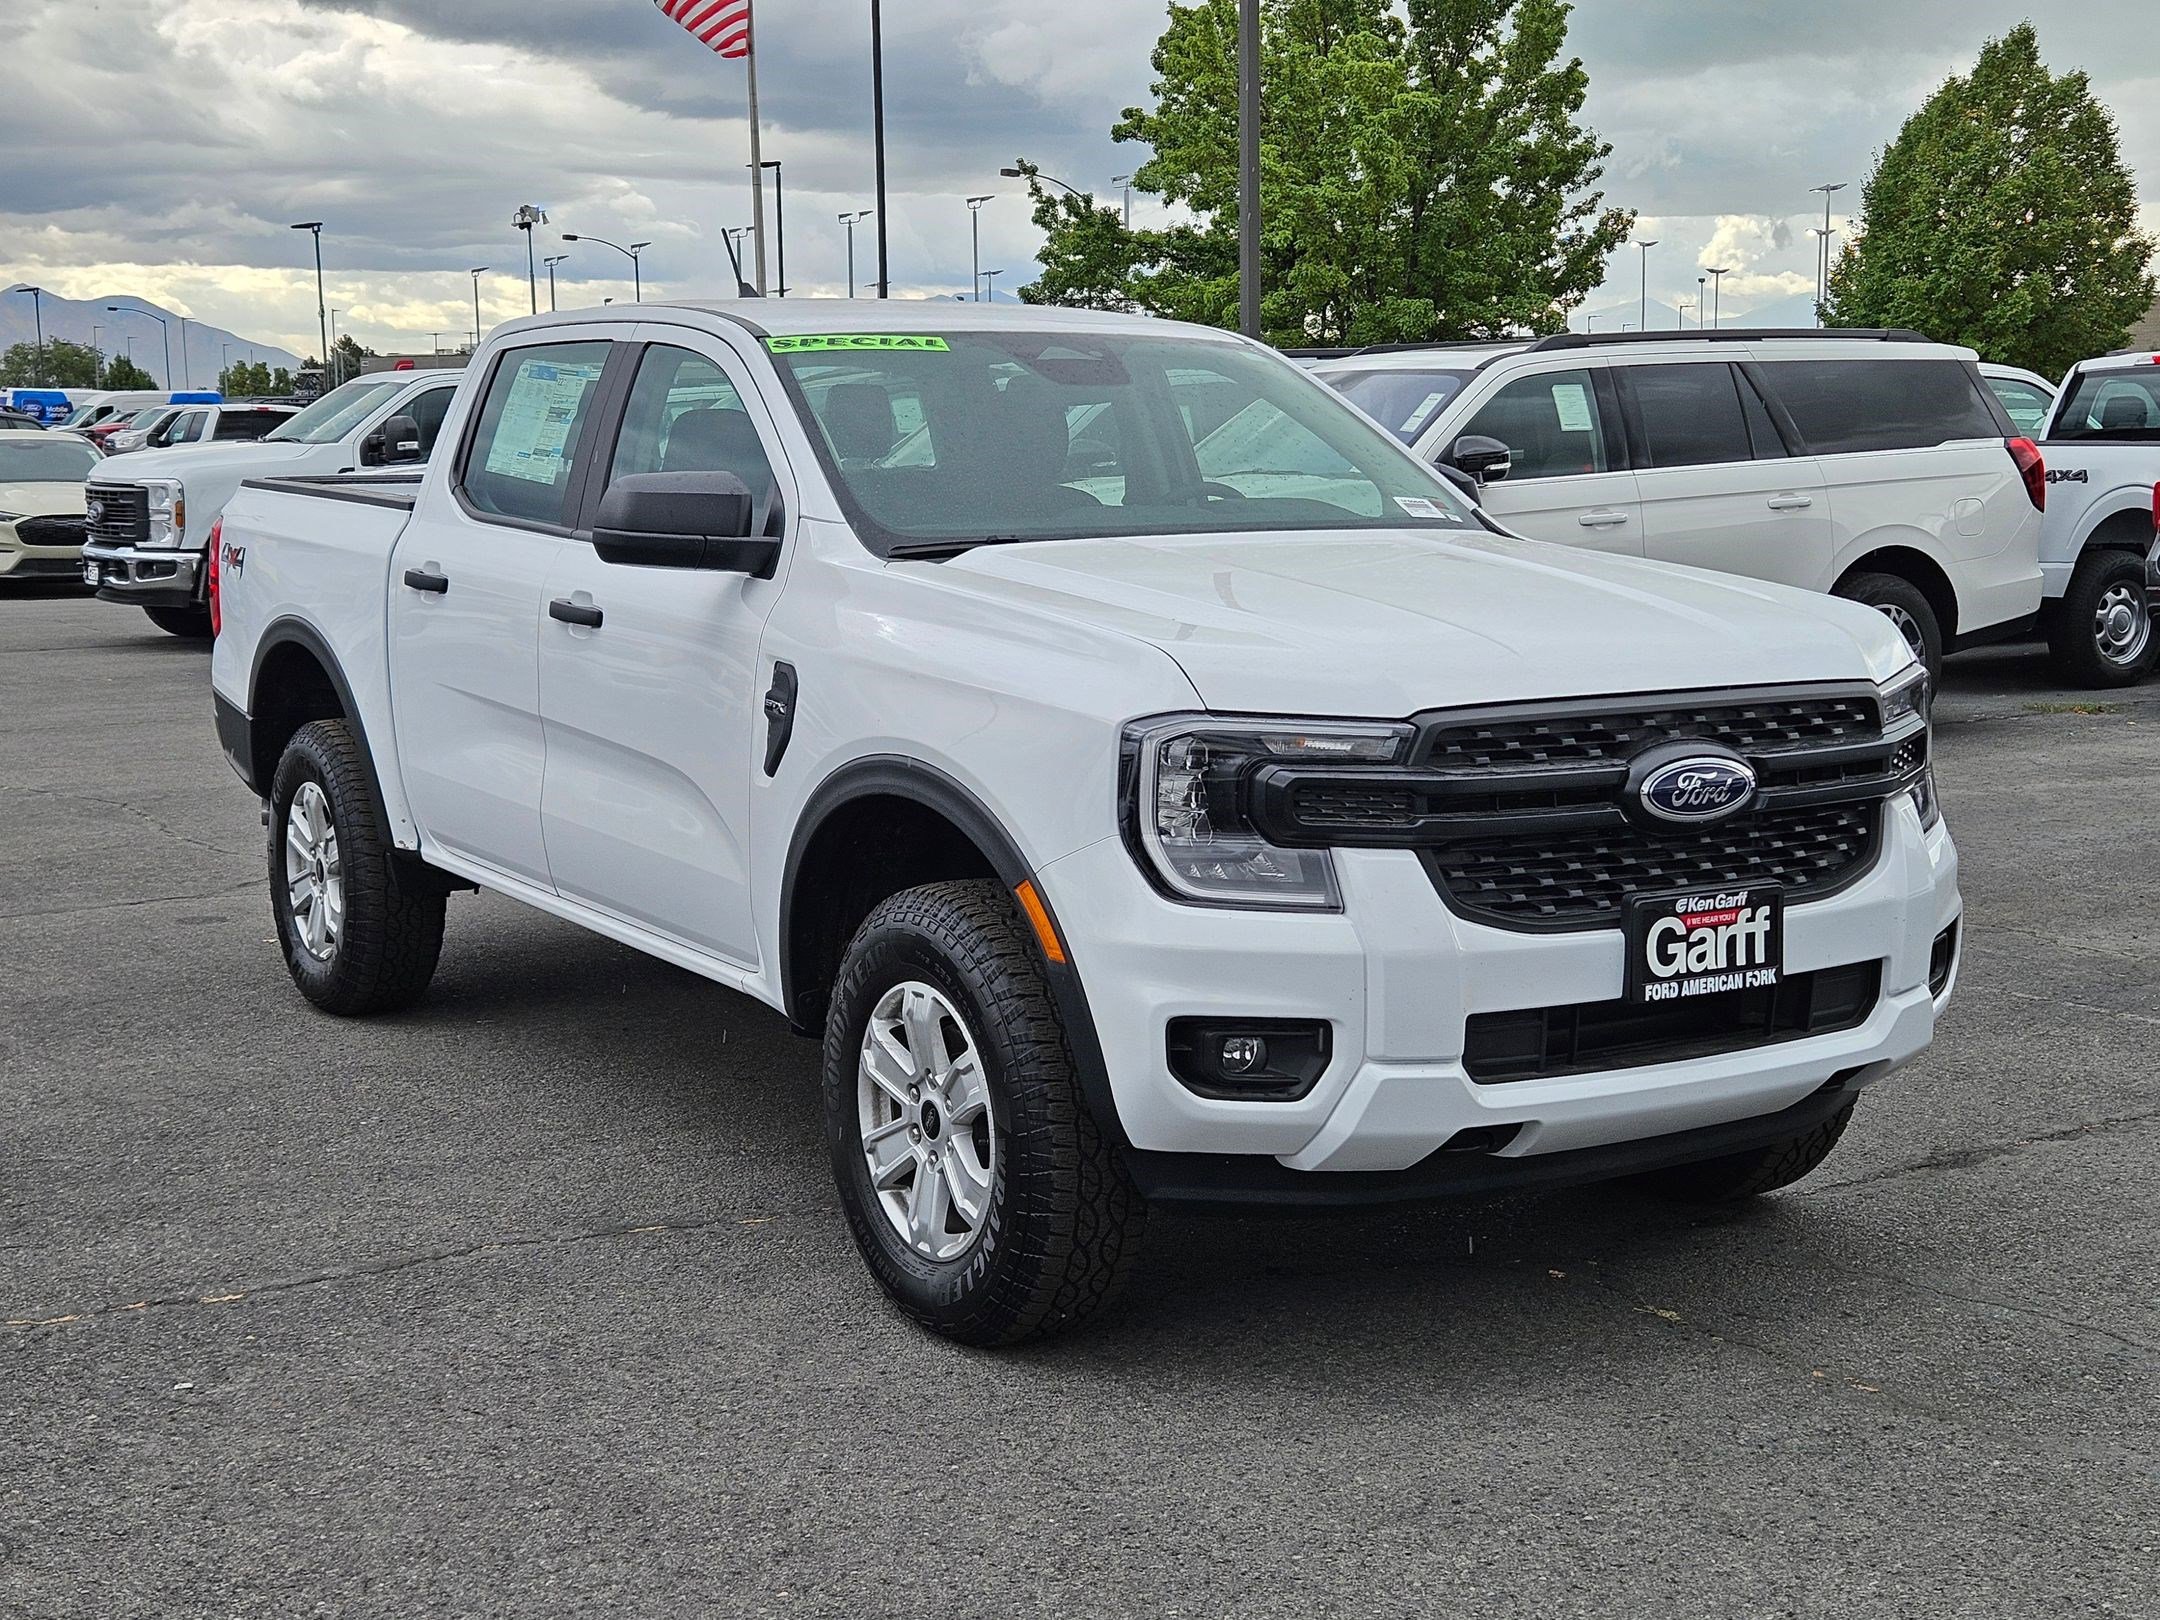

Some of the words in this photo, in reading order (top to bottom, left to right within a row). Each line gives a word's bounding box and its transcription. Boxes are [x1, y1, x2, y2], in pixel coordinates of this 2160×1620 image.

[770, 336, 946, 349] SPECIAL
[1671, 771, 1733, 807] Ford
[1687, 896, 1715, 913] Ken
[1715, 891, 1748, 910] Garff
[1690, 917, 1701, 925] WE
[1702, 915, 1719, 924] HEAR
[1719, 914, 1732, 922] YOU
[1646, 905, 1771, 978] Garff
[1644, 982, 1679, 1001] FORD
[1681, 971, 1743, 997] AMERICAN
[1745, 968, 1777, 986] FORK
